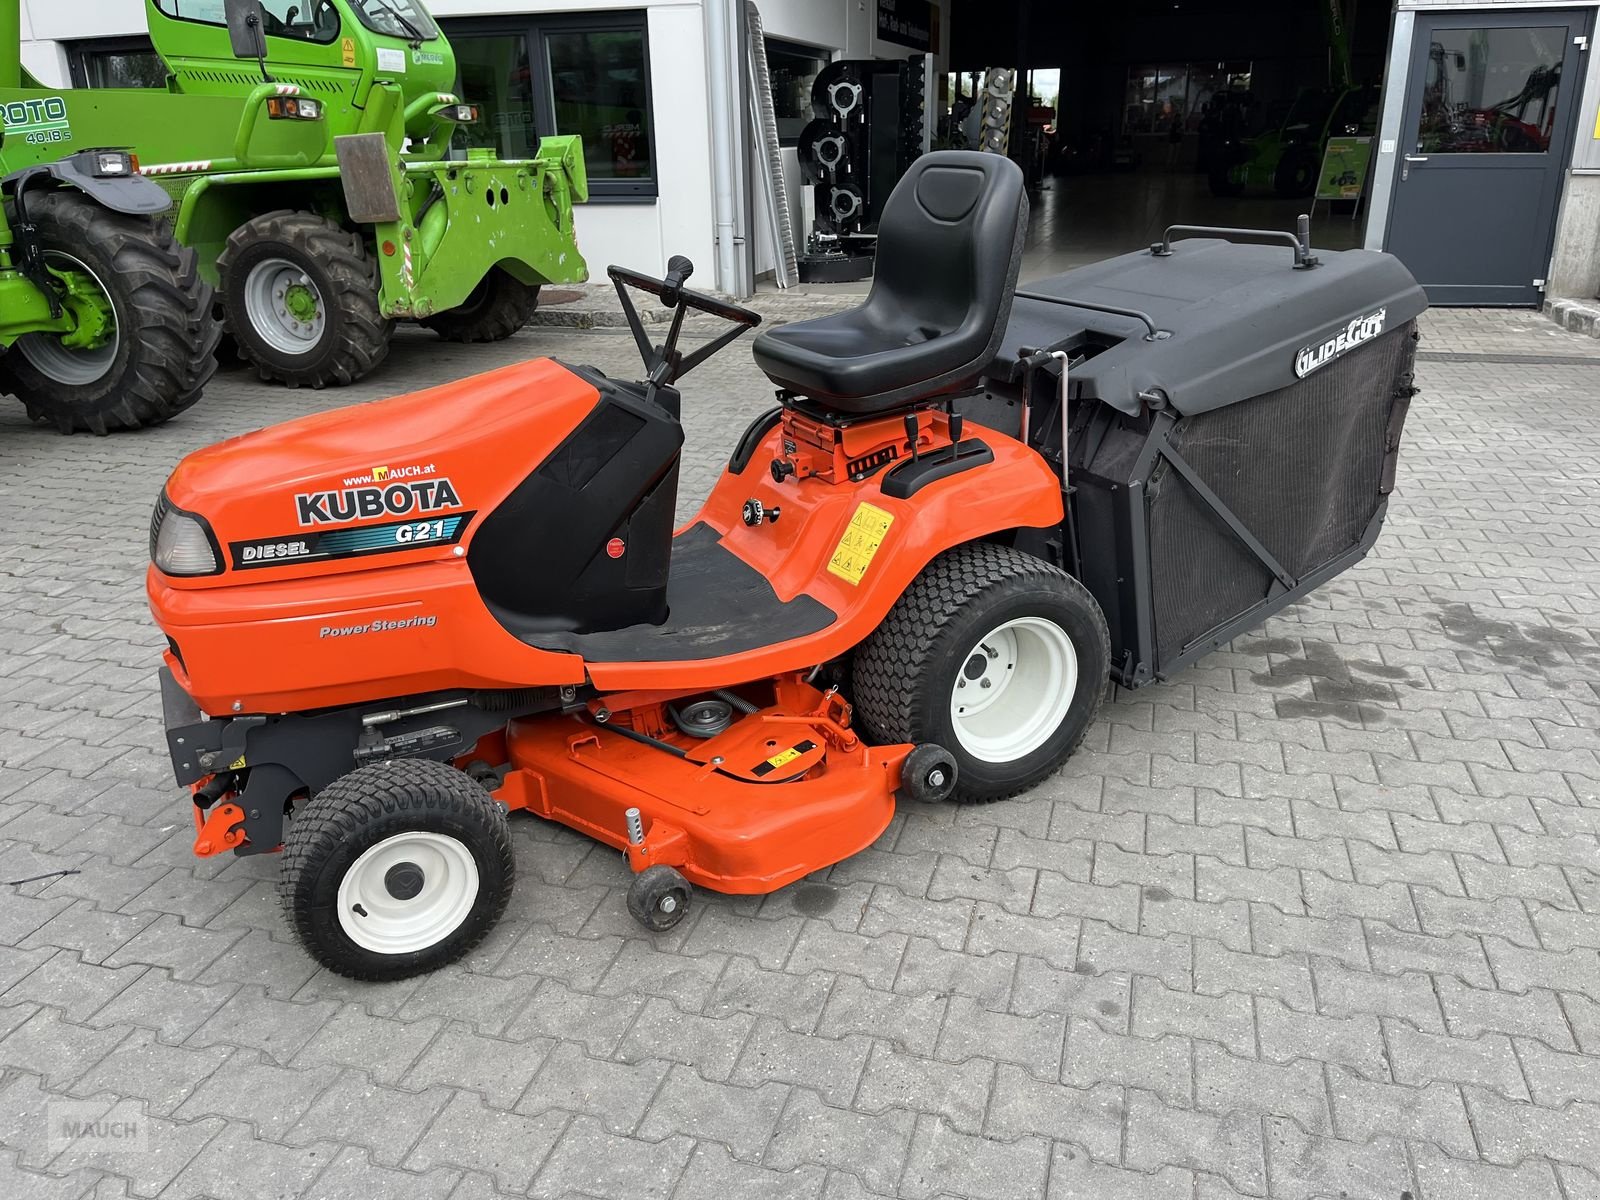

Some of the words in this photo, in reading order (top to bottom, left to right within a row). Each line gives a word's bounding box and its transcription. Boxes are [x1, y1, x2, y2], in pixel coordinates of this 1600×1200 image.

[26, 130, 62, 144] 40.18
[343, 463, 436, 487] www.MAUCH.at
[295, 478, 462, 526] KUBOTA
[395, 520, 446, 543] G21
[242, 541, 310, 561] DIESEL
